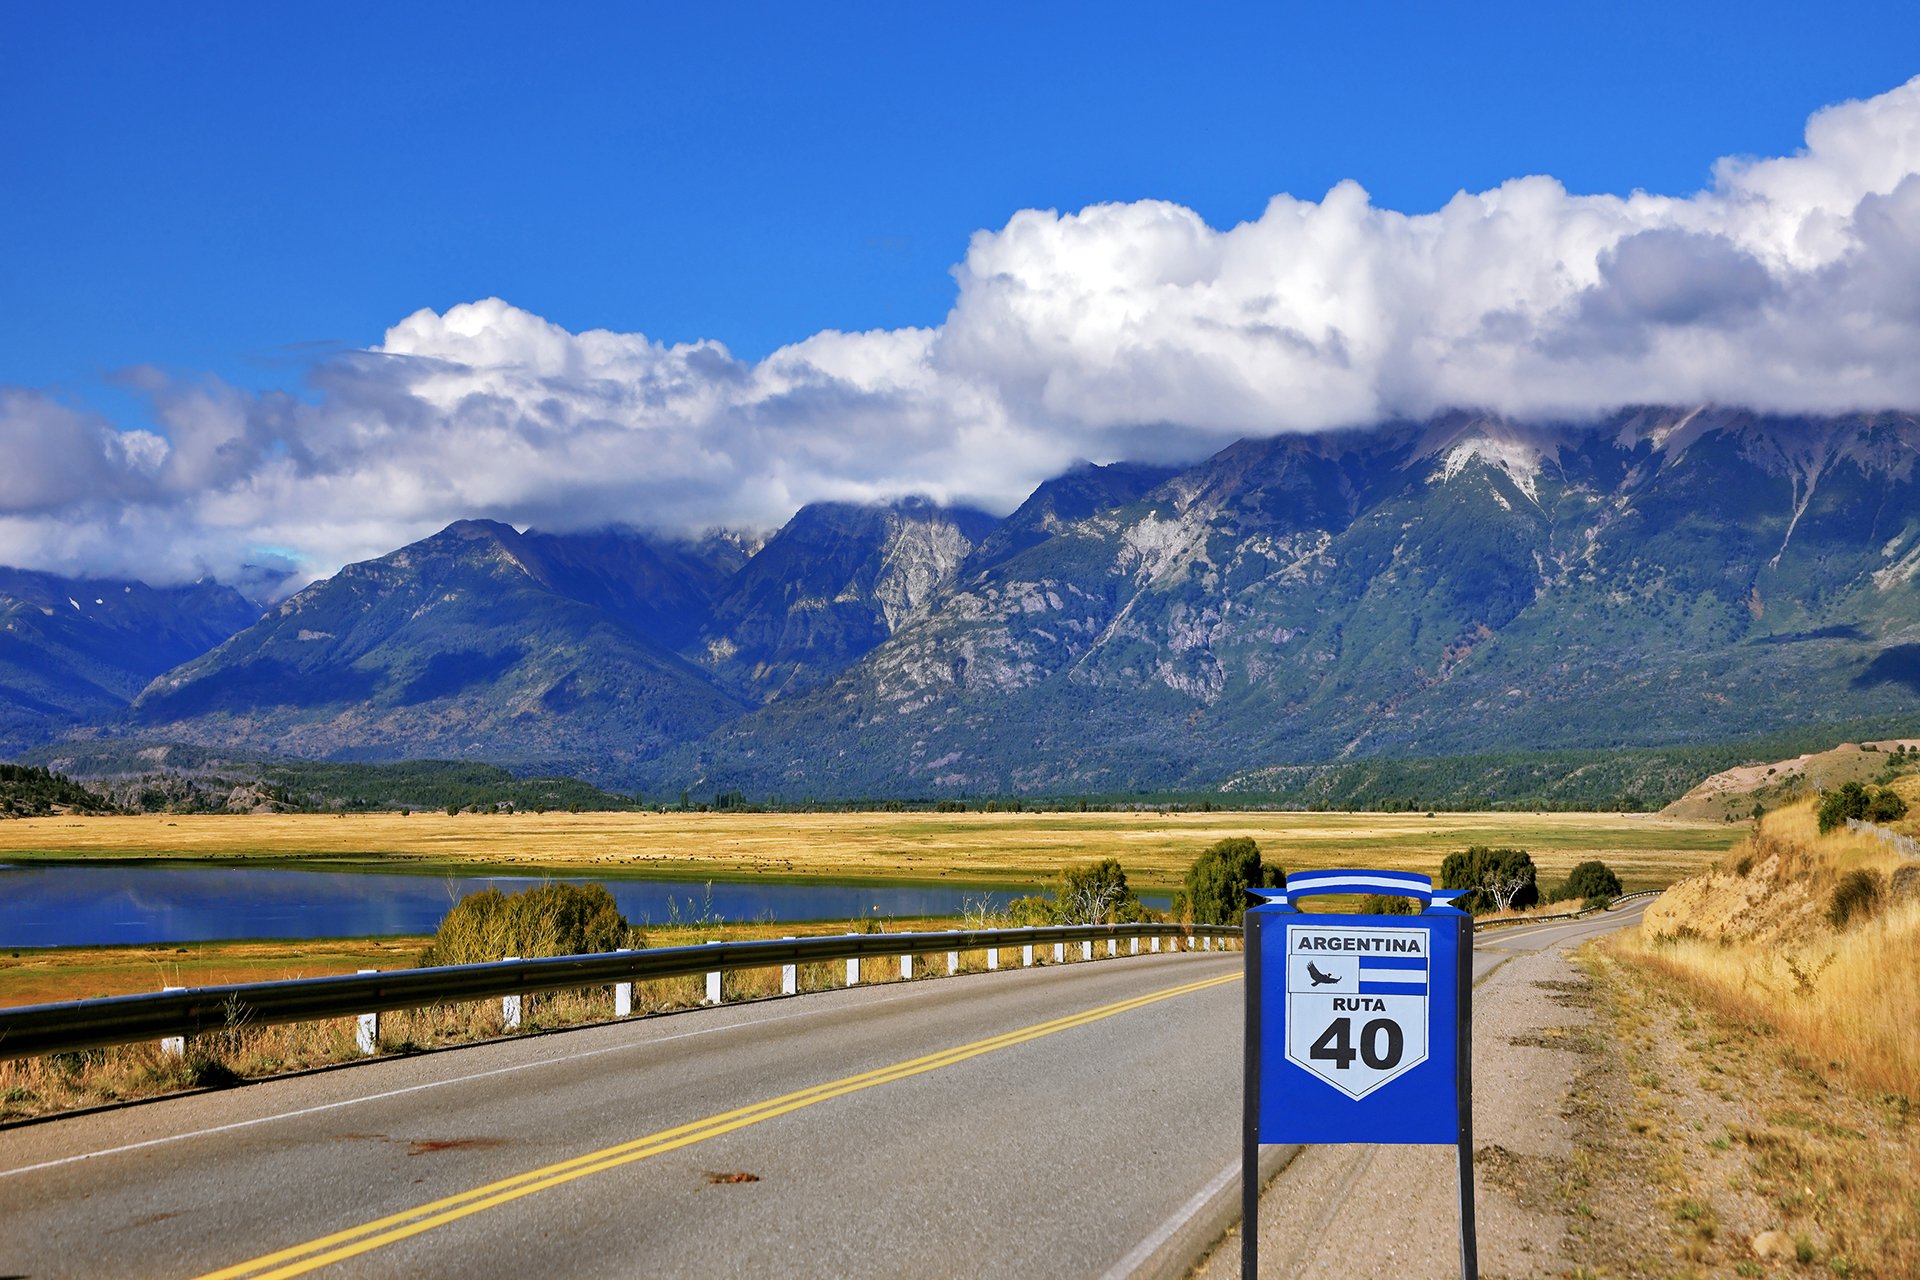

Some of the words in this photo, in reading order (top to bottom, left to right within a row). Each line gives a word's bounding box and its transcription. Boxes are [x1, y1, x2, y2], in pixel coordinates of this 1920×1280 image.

[1298, 936, 1421, 953] ARGENTINA
[1333, 997, 1386, 1012] RUTA
[1309, 1017, 1404, 1071] 40
